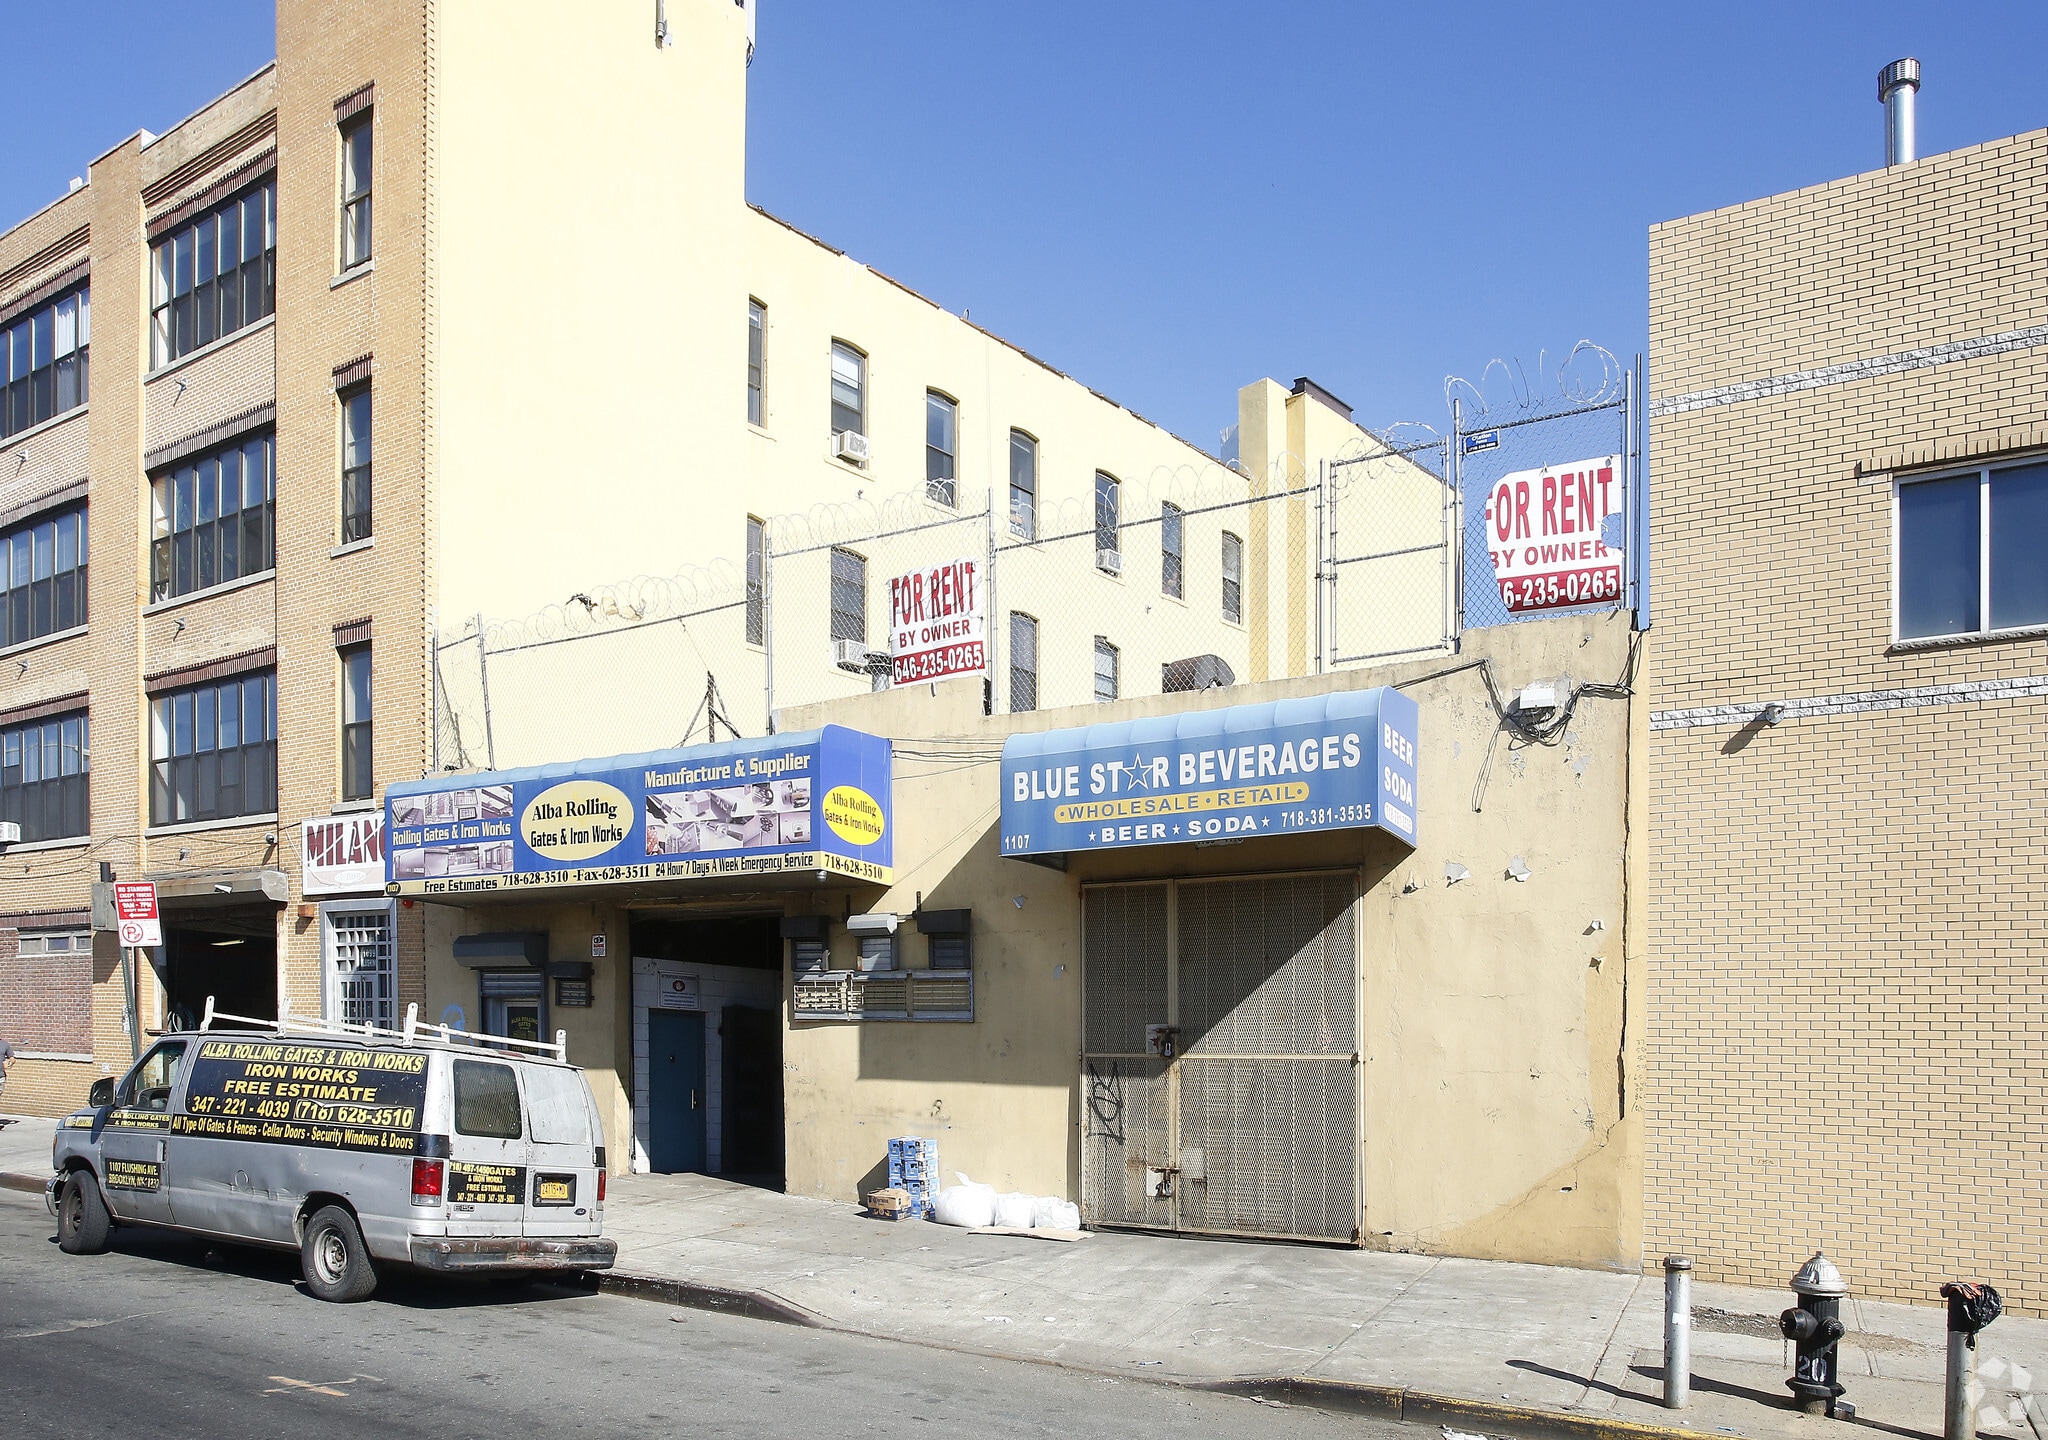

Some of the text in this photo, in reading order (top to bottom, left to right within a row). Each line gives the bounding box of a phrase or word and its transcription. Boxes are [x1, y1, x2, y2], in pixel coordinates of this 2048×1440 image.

[1542, 467, 1613, 536] RENT
[1524, 540, 1608, 566] OWNER
[891, 561, 976, 628] FOR RENT
[1502, 568, 1618, 608] 6-235-0265
[899, 618, 971, 648] BY OWNER
[894, 644, 983, 683] 646-235-0265
[1384, 722, 1414, 768] BEER
[645, 752, 811, 788] Manufacture & Supplier
[1013, 765, 1080, 802] BLUE
[1179, 732, 1361, 786] BEVERAGES
[1384, 765, 1413, 808] SODA
[532, 798, 618, 822] Alba Rolling
[830, 792, 877, 819] Alba Rolling
[1068, 786, 1296, 820] WHOLESALE RETAIL
[1281, 803, 1372, 828] 718-381-3535
[392, 820, 512, 847] Rolling Gates & Iron Works
[824, 808, 881, 835] Gates & Iron Works
[1101, 815, 1258, 843] BEER SODA
[530, 824, 623, 848] Gates & Iron Works
[1004, 834, 1030, 850] 1107
[424, 880, 445, 893] Free
[448, 878, 498, 892] Estimates
[502, 870, 569, 888] 718-628-3510
[655, 862, 666, 877] 24
[667, 861, 684, 877] Hour
[685, 861, 691, 875] 7
[692, 859, 710, 876] Days
[711, 858, 718, 873] A
[719, 857, 739, 872] Week
[741, 855, 783, 872] Emergency
[784, 851, 813, 869] Service
[824, 854, 883, 880] 718-628-3510
[387, 884, 399, 893] 1107
[201, 1042, 424, 1072] ALBA ROLLING GATES & IRON WORKS
[244, 1064, 359, 1084] IRON WORKS
[223, 1080, 378, 1102] FREE ESTIMATE
[122, 1112, 149, 1120] ROLLING
[149, 1113, 171, 1122] GATES
[191, 1096, 214, 1113] 347
[223, 1097, 247, 1114] 221
[257, 1100, 290, 1118] 4039
[337, 1106, 413, 1128] 628-3510
[172, 1115, 181, 1130] All
[183, 1116, 198, 1134] Type
[198, 1119, 206, 1130] Of
[206, 1119, 225, 1134] Gates
[226, 1121, 232, 1134] &
[233, 1120, 257, 1137] Fences
[262, 1123, 283, 1139] Cellar
[283, 1124, 305, 1140] Doors
[311, 1125, 342, 1145] Security
[344, 1129, 379, 1147] Windows
[381, 1133, 388, 1147] &
[389, 1134, 414, 1150] Doors
[109, 1161, 159, 1176] 1107 FLUSHING AVE.
[472, 1175, 486, 1183] IRON
[485, 1176, 504, 1184] WORKS
[489, 1166, 517, 1177] GATES
[466, 1183, 507, 1193] FREE ESTIMATE
[1797, 1355, 1827, 1382] 20
